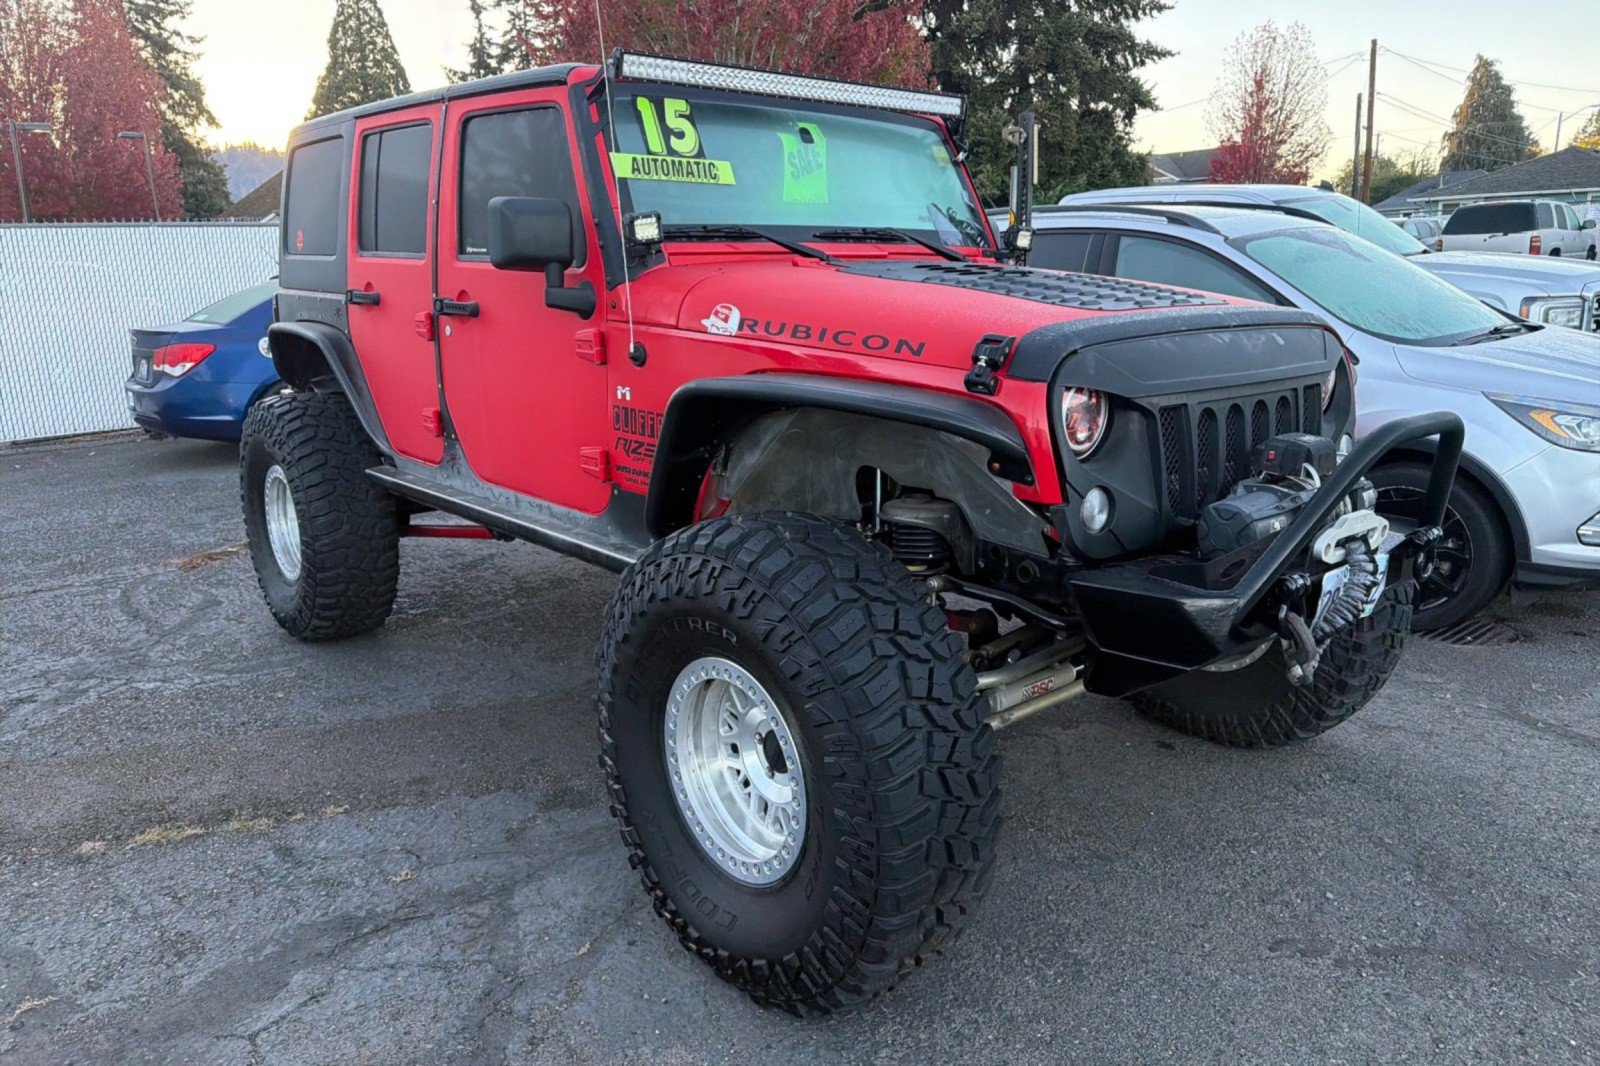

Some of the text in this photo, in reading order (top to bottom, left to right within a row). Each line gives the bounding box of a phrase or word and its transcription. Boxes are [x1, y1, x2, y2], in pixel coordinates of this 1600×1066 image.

[637, 97, 699, 156] 15
[630, 156, 719, 181] AUTOMATIC
[738, 317, 926, 357] RUBICON
